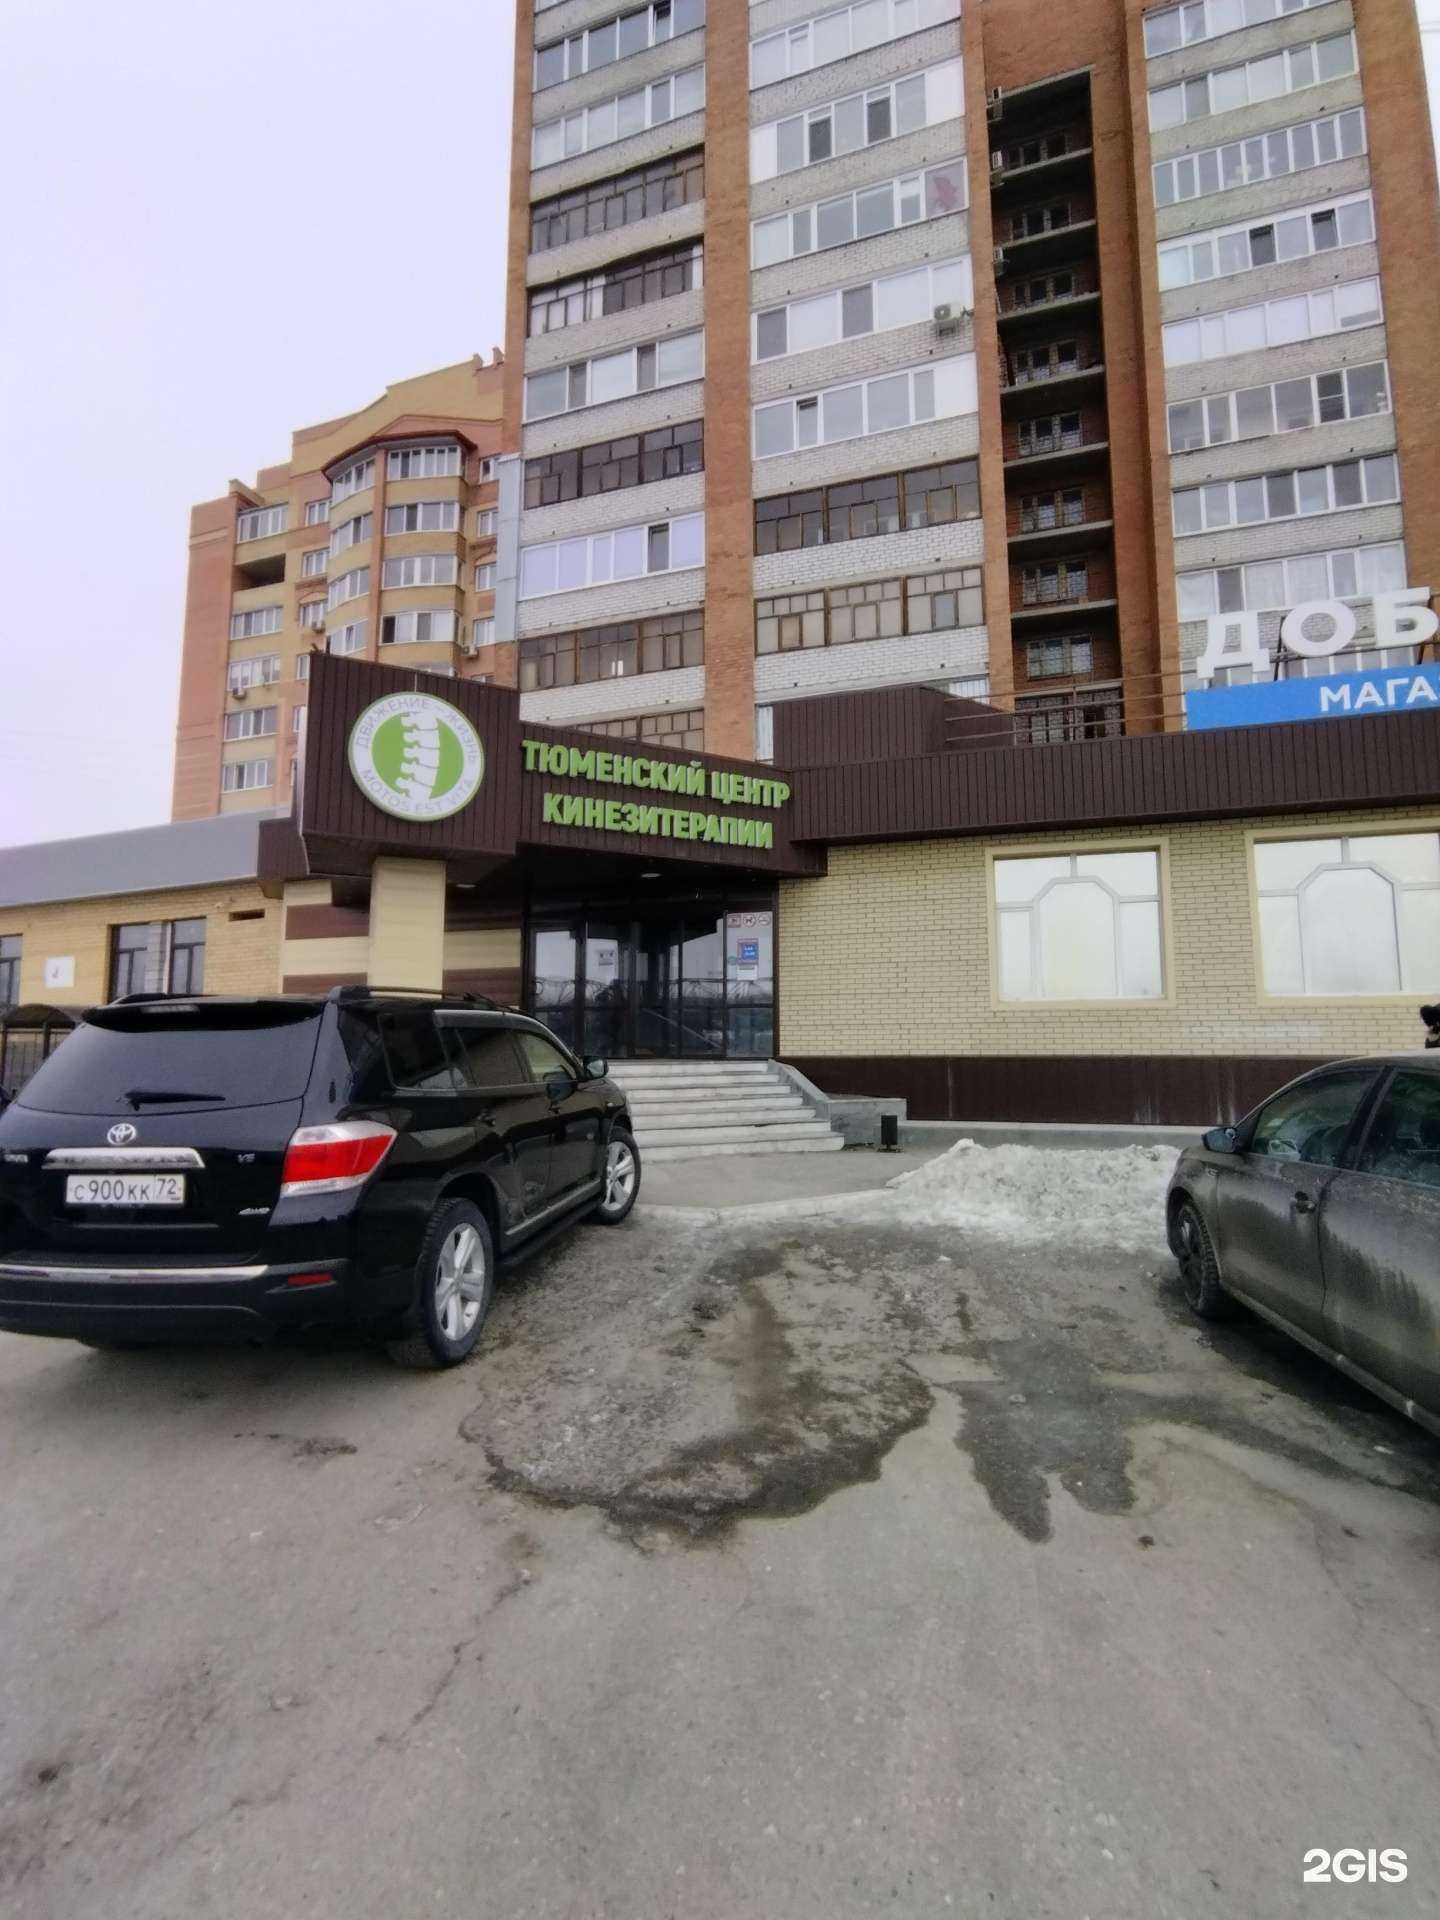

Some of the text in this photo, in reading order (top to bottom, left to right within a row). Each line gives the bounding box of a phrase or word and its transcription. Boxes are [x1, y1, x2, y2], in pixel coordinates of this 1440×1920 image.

[1197, 587, 1439, 679] ДОБ
[1320, 675, 1440, 712] МАГА
[356, 698, 478, 761] ДВИЖЕНИЕ ЖИЗНЬ
[522, 740, 790, 808] ТЮМЕНСКИЙ ЦЕНТР
[543, 792, 773, 849] КИНЕЗИТЕРАПИИ
